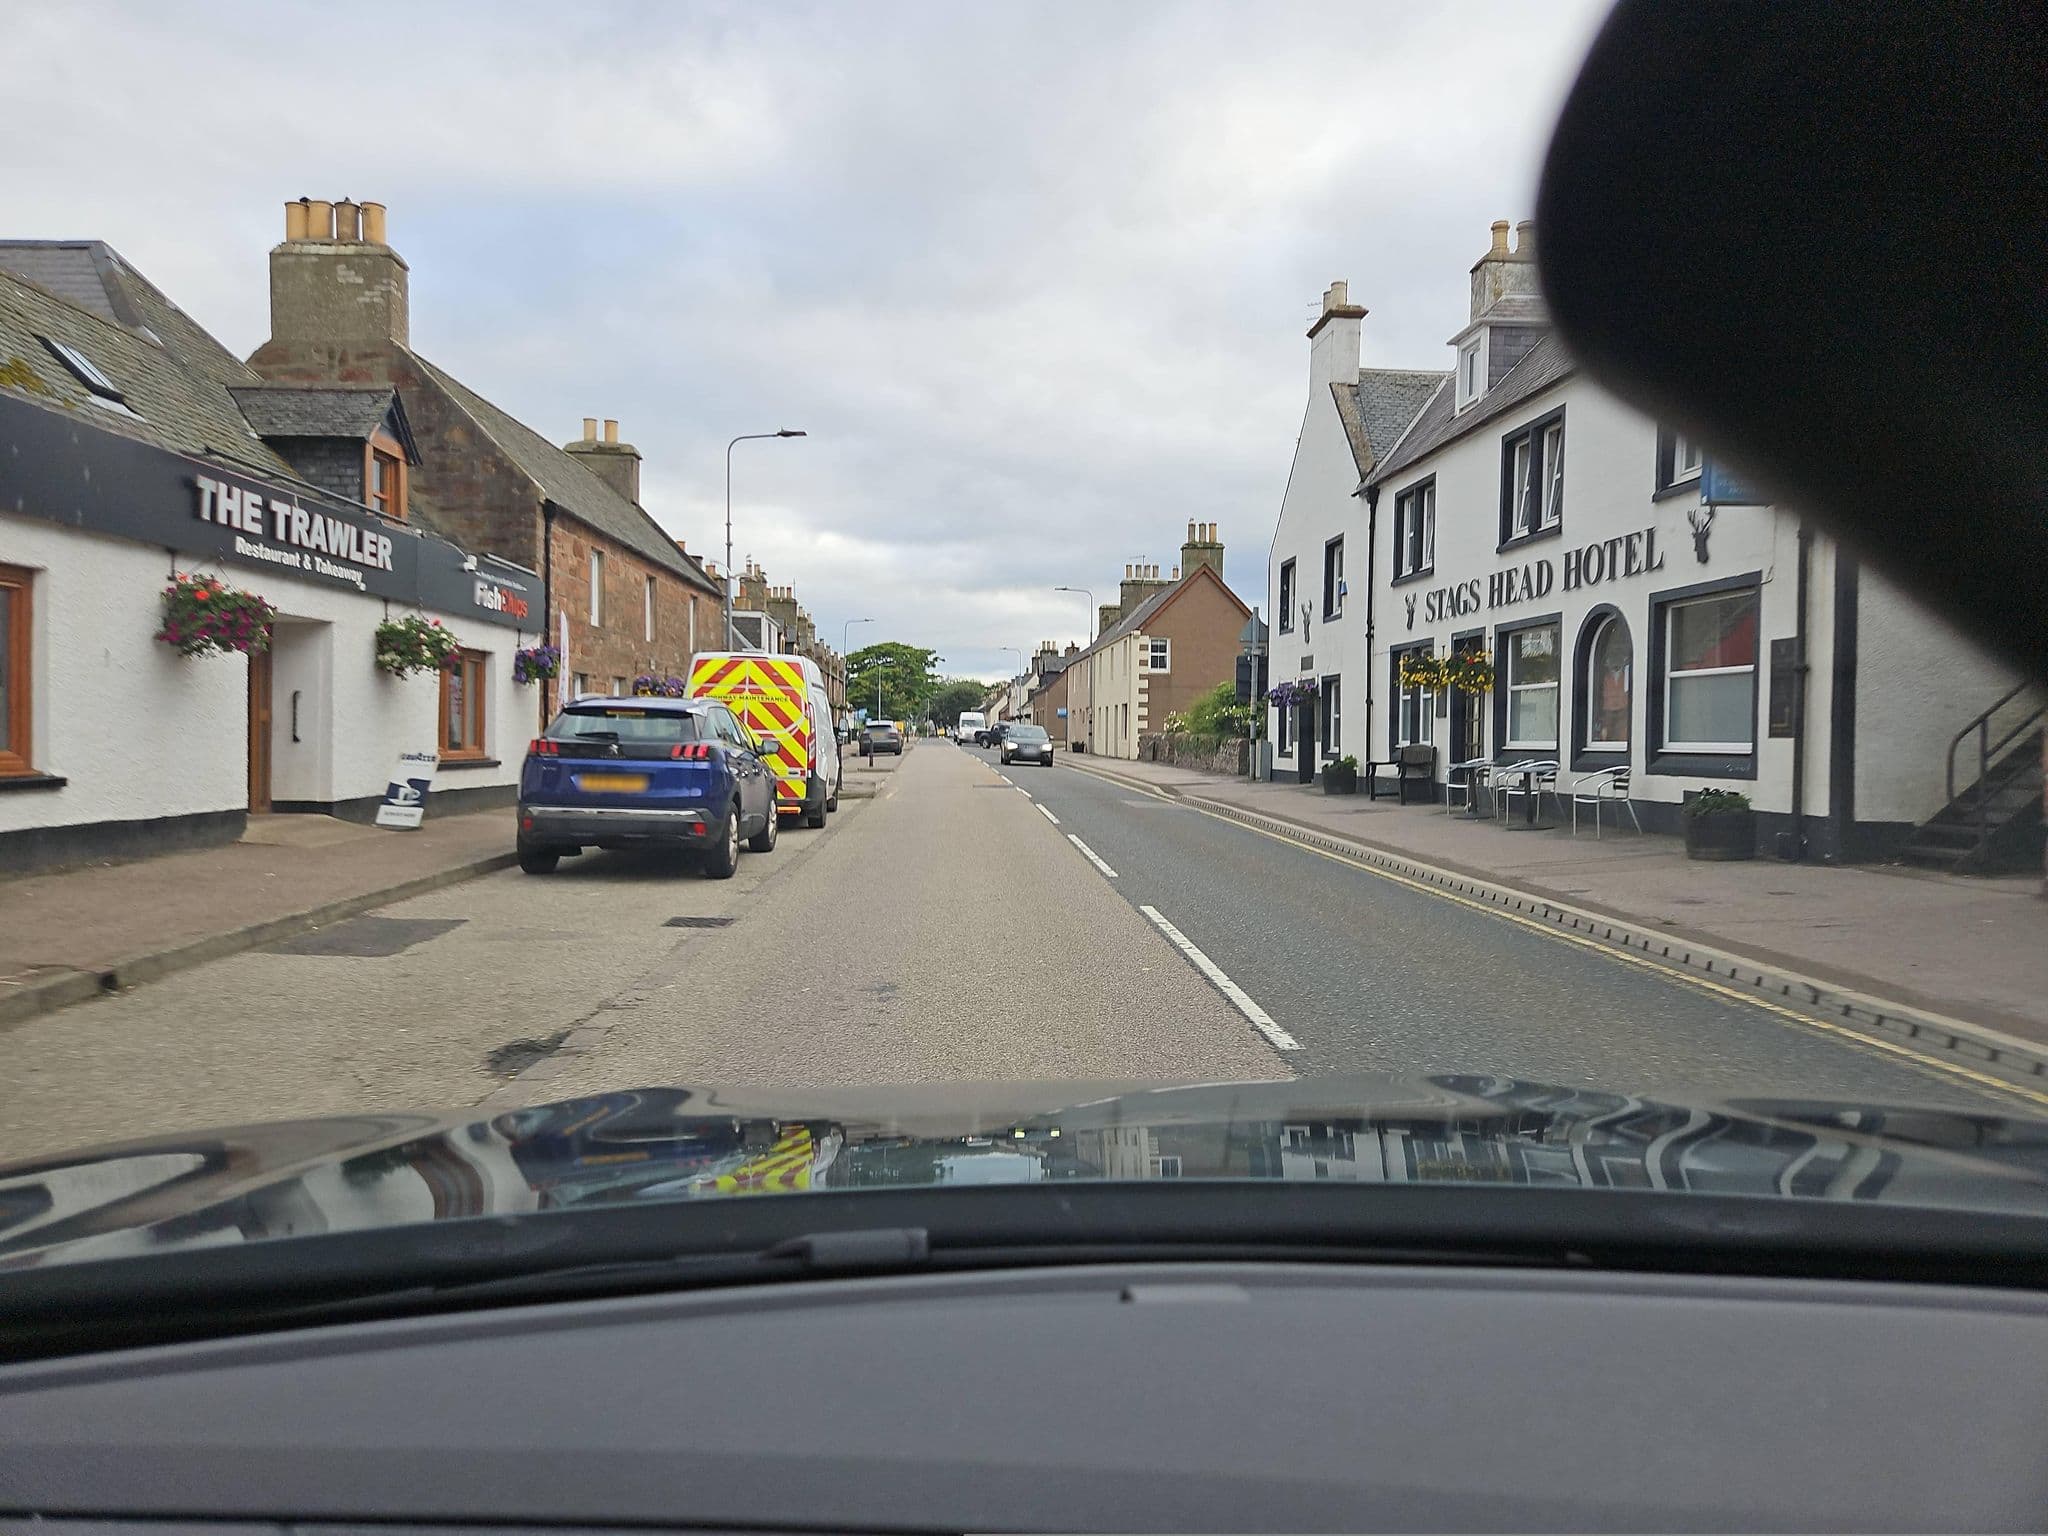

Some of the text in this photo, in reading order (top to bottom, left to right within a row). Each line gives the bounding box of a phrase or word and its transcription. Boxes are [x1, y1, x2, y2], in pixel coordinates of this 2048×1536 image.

[196, 474, 394, 571] THE TRAWLER
[235, 535, 366, 588] Restaurant & Takeaway
[1425, 526, 1665, 623] STAGS HEAD HOTEL
